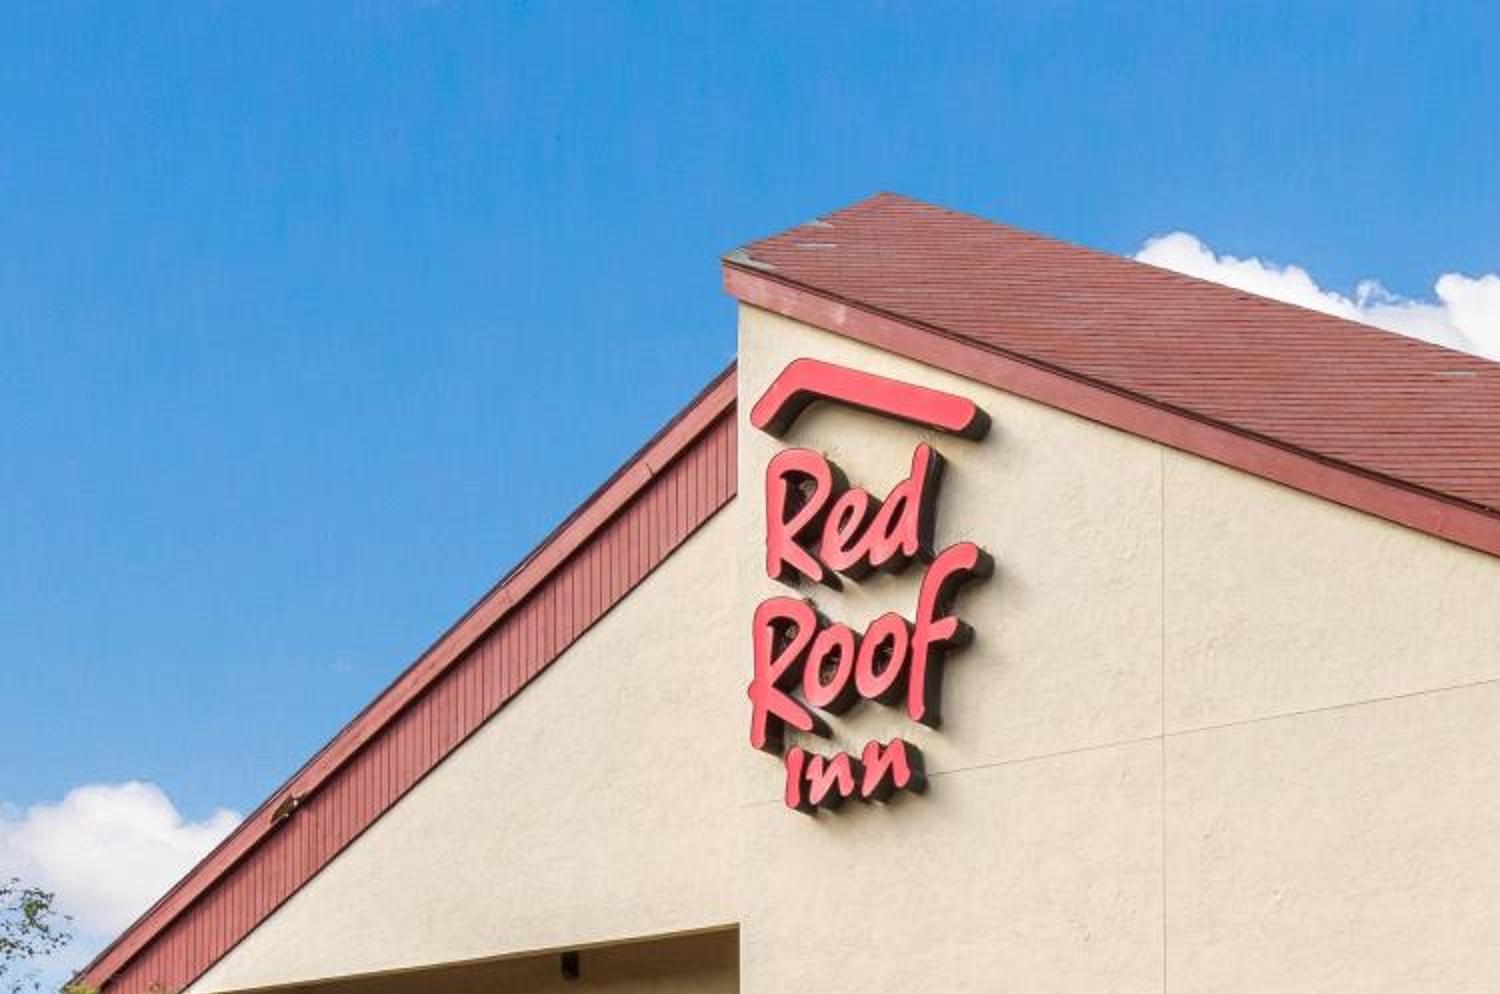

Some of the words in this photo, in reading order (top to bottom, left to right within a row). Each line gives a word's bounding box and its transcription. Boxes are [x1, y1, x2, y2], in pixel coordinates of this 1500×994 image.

[765, 442, 938, 586] Red
[748, 542, 984, 752] Roof
[785, 738, 917, 811] Inn
